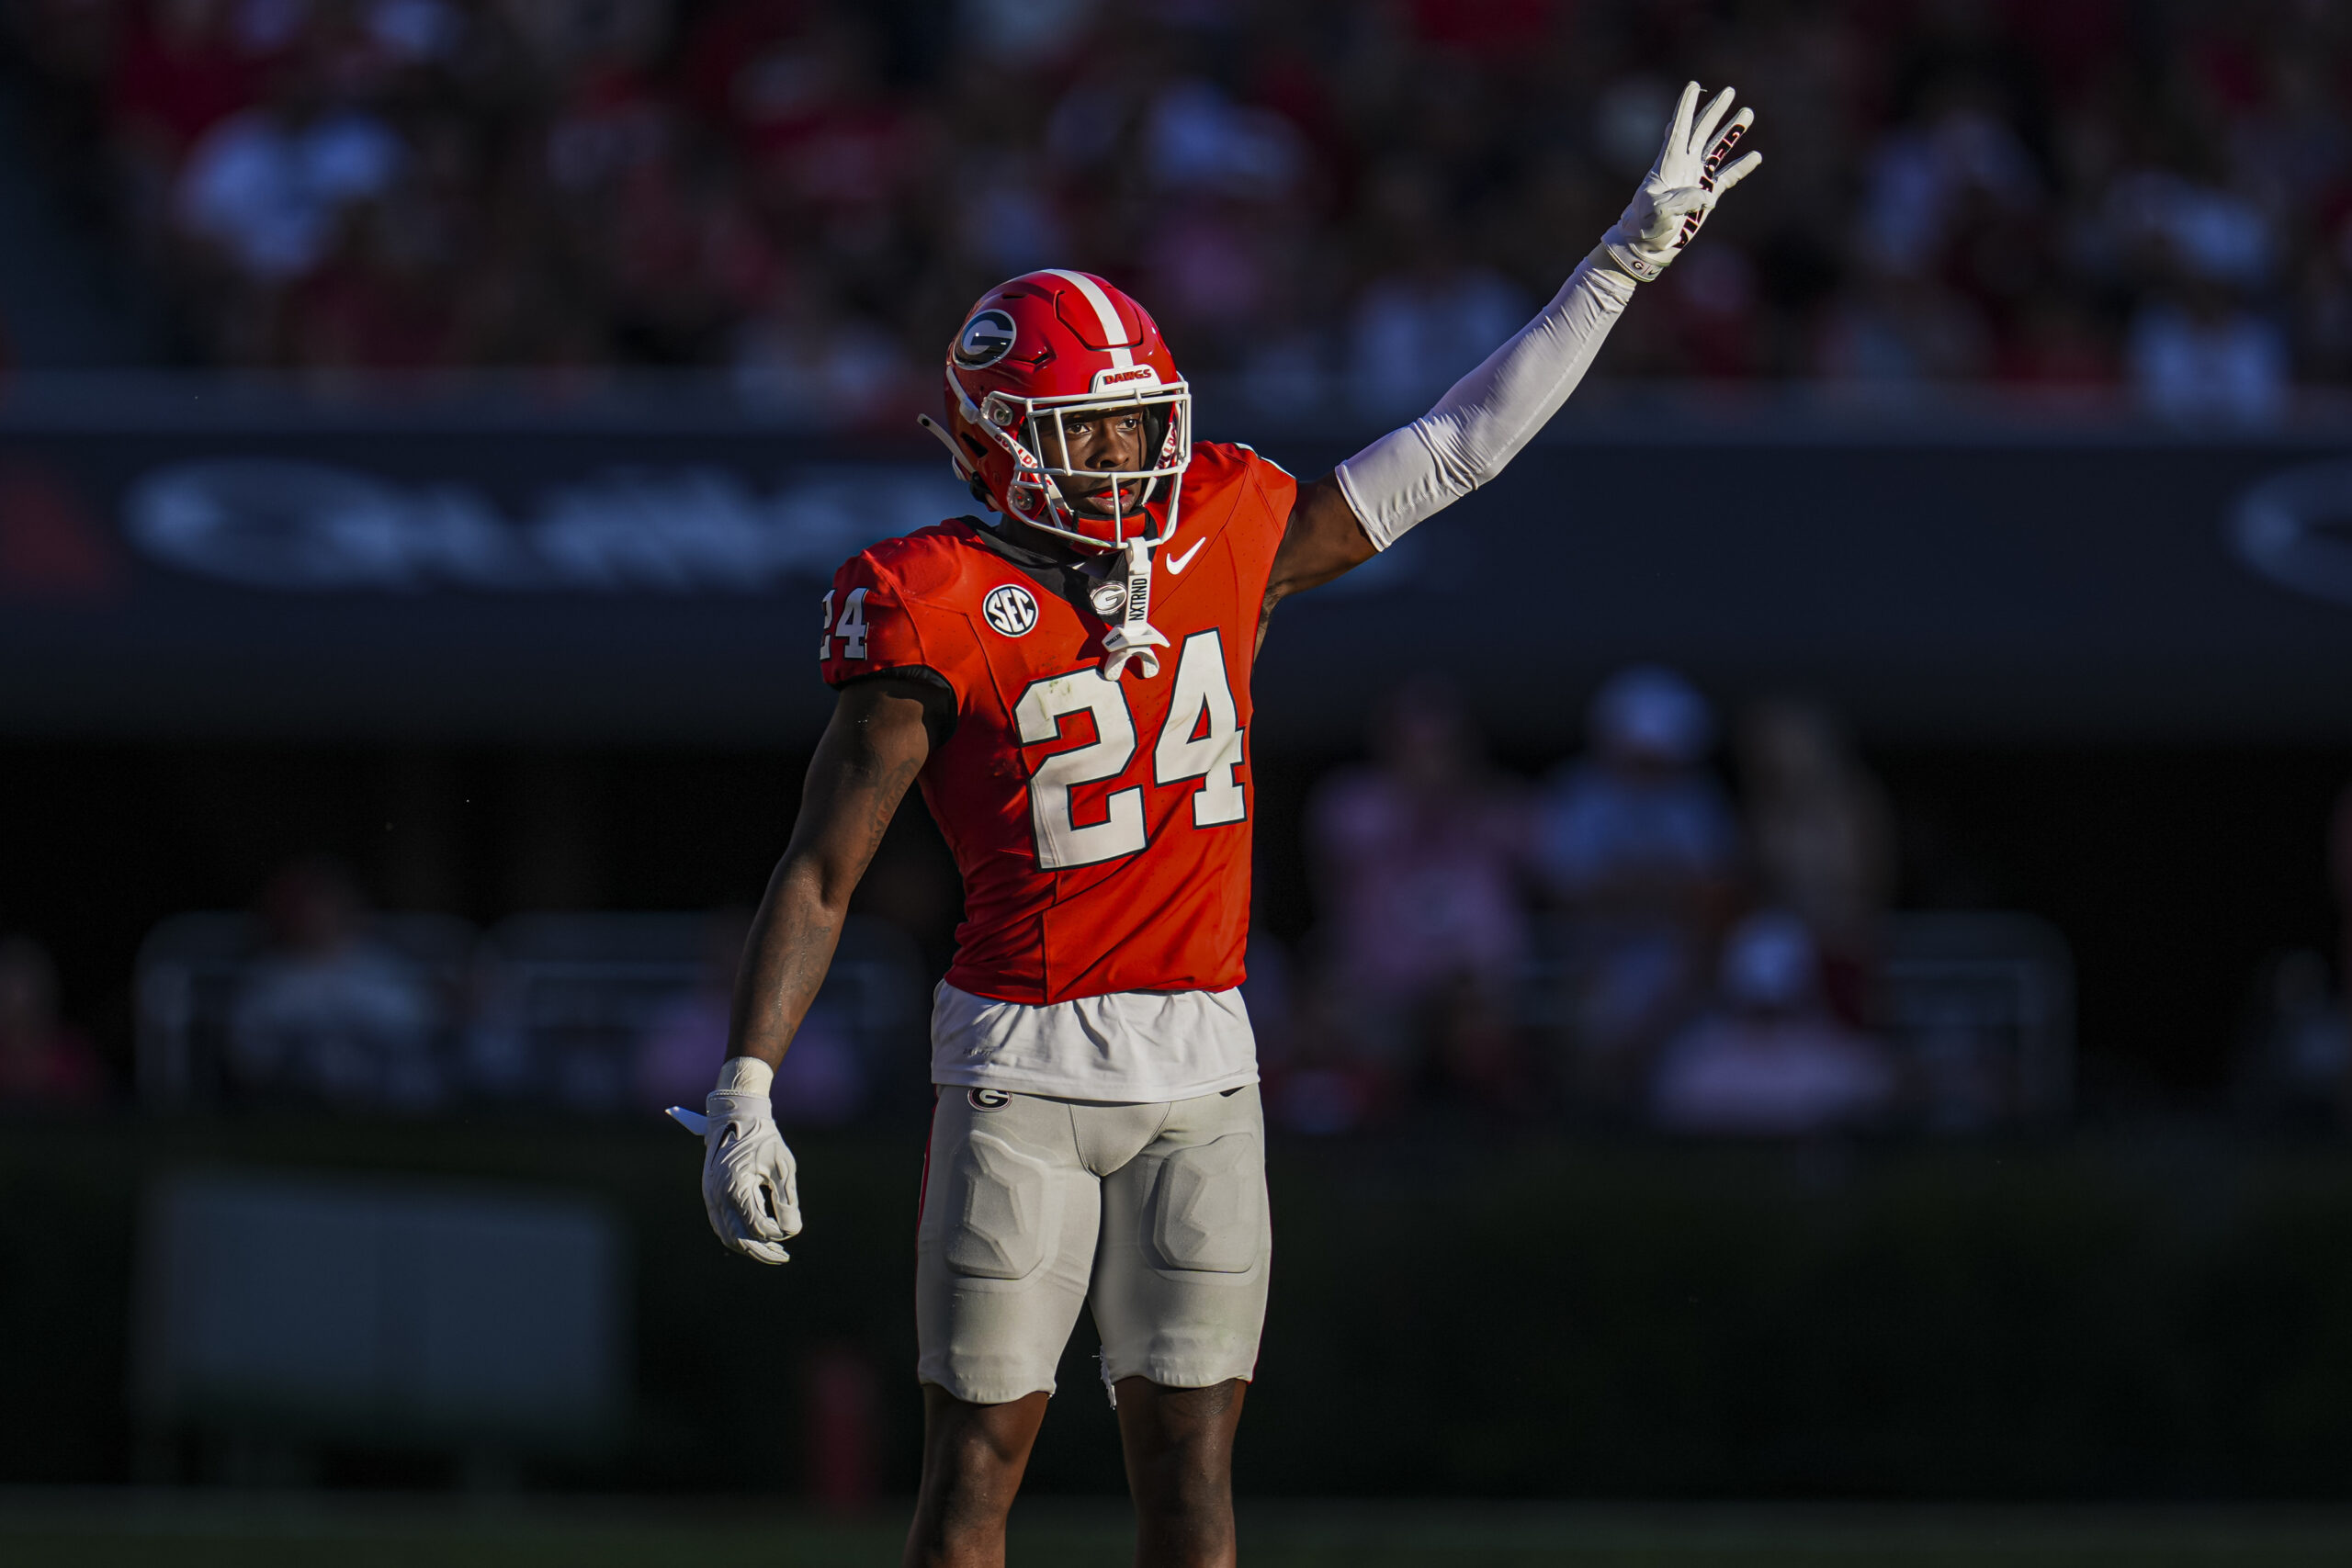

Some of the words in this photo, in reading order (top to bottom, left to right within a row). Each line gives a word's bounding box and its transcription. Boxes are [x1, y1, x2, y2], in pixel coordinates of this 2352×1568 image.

[958, 314, 1014, 361] G
[1102, 369, 1152, 385] DAWGS
[987, 587, 1035, 634] SEC
[1092, 586, 1126, 613] G
[1128, 579, 1148, 621] NXTRND
[1013, 627, 1248, 873] 24
[974, 1088, 1011, 1108] G
